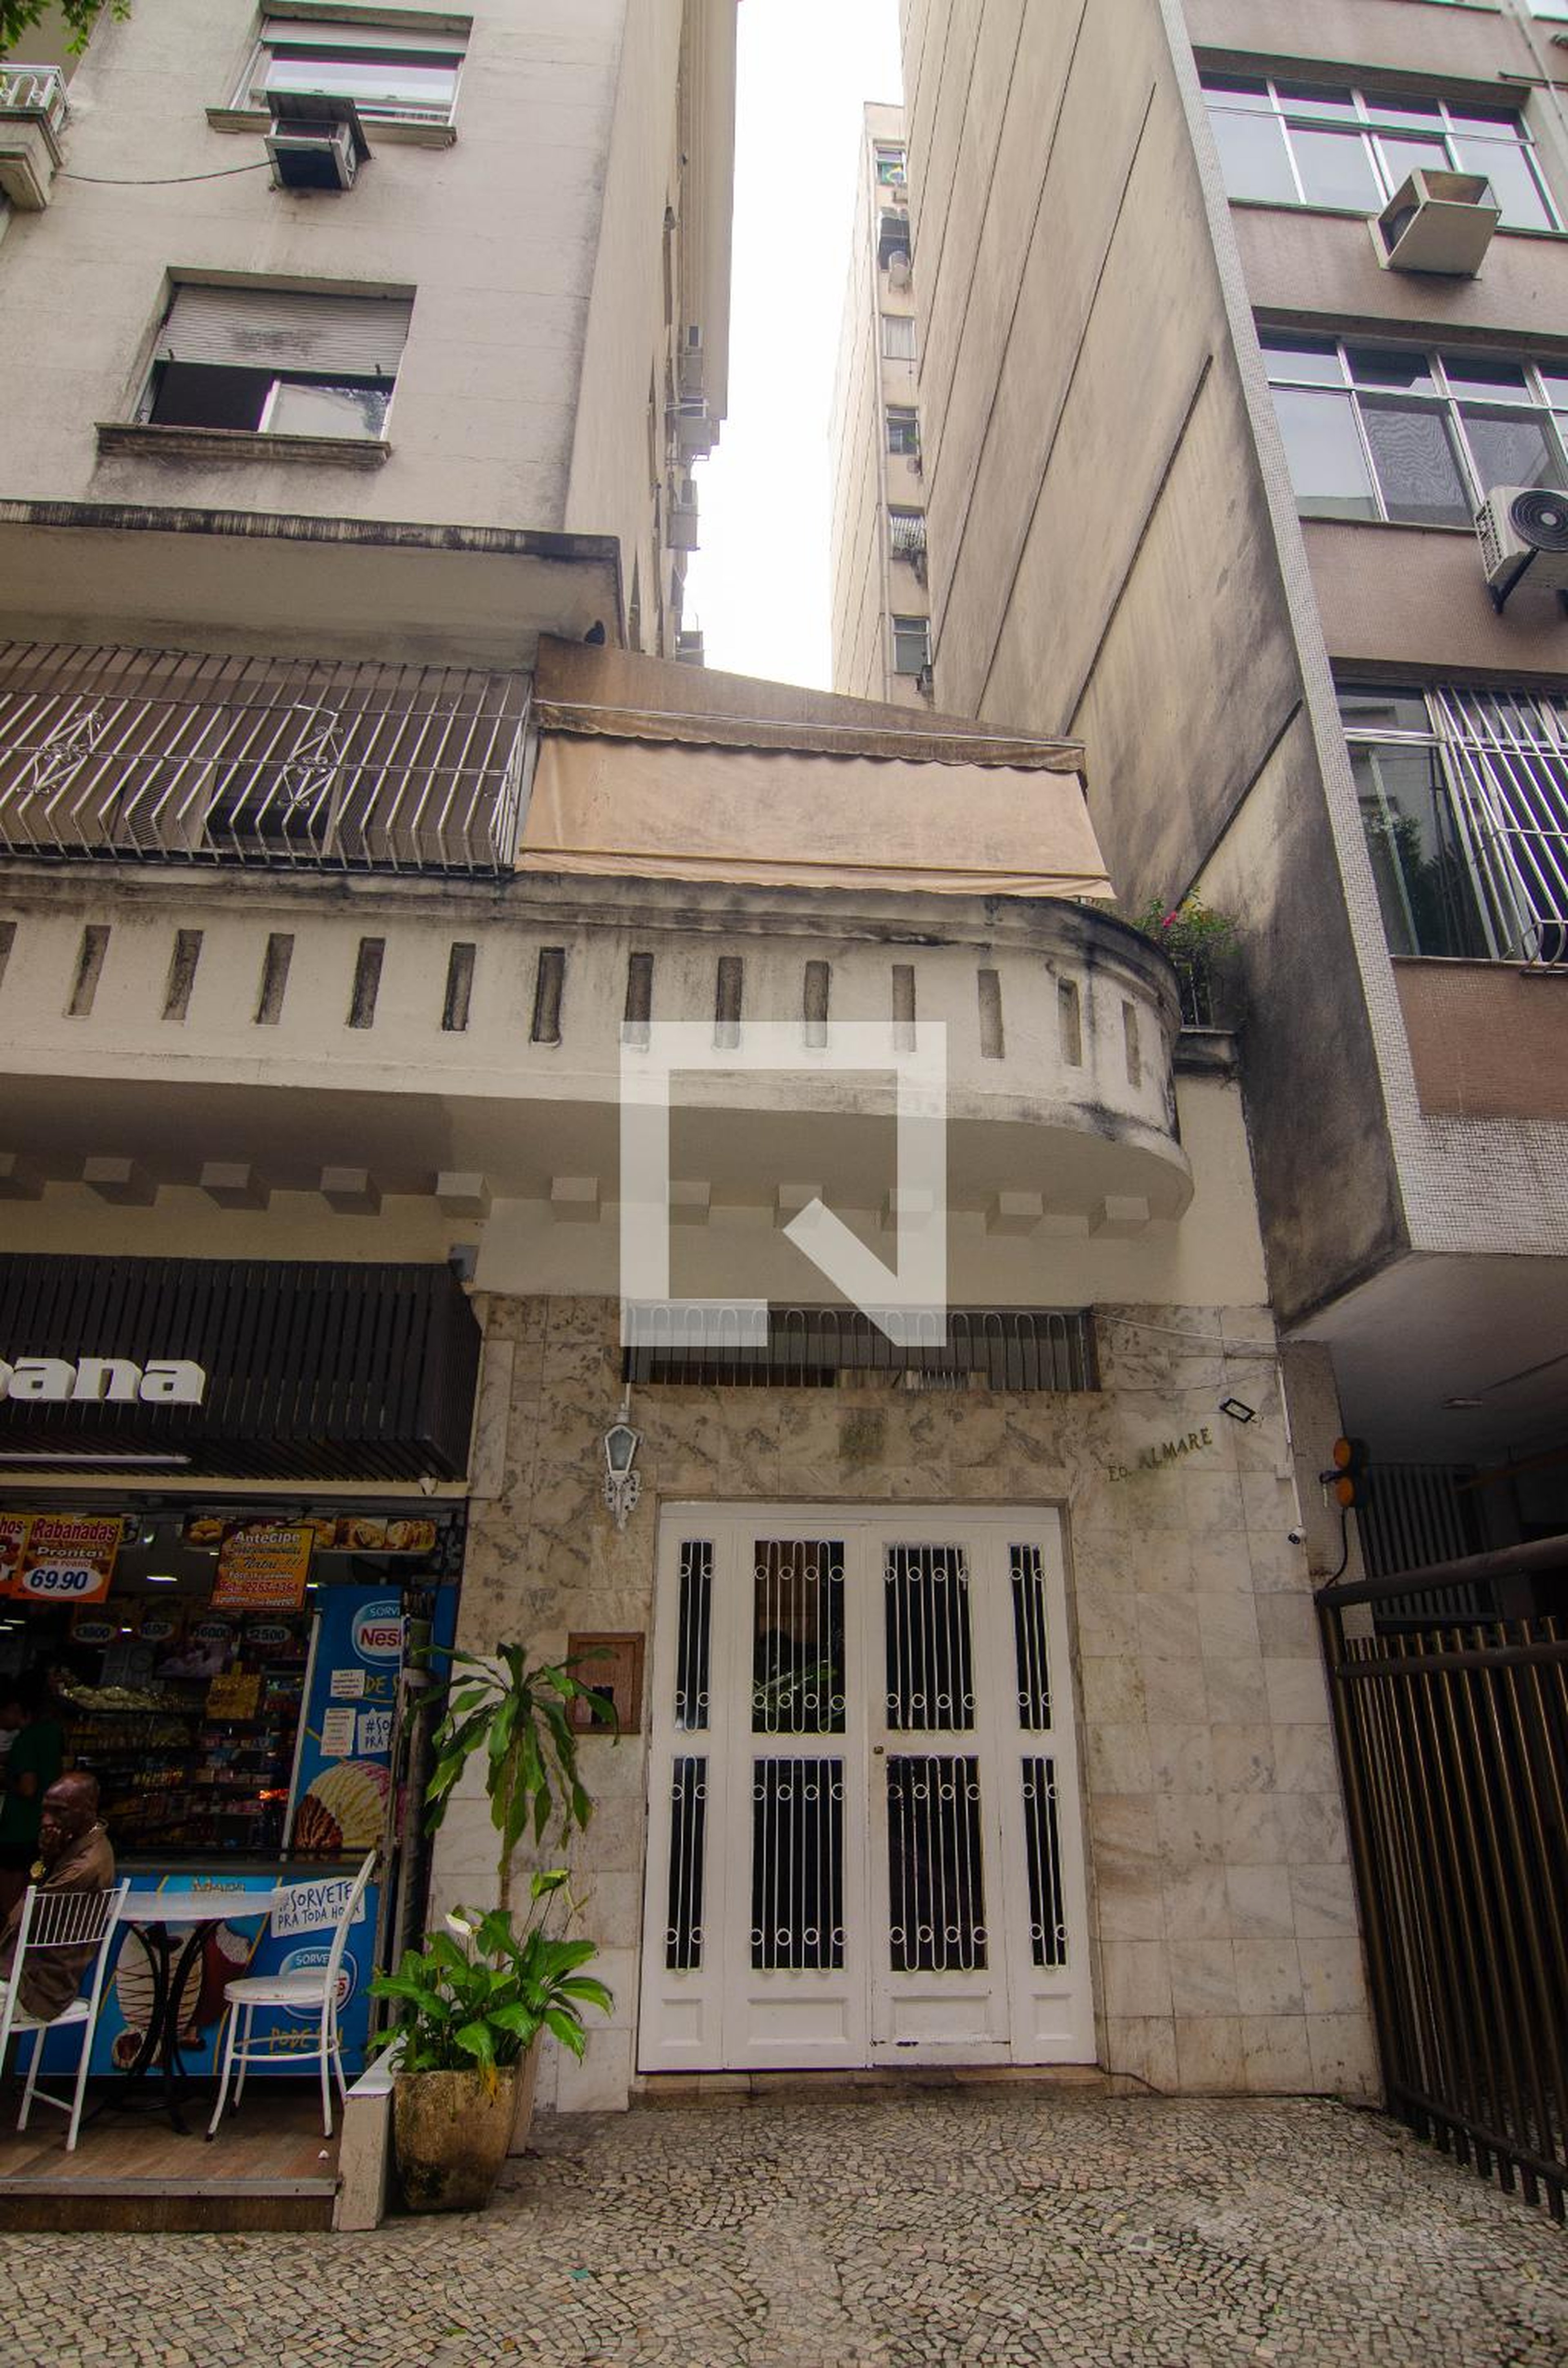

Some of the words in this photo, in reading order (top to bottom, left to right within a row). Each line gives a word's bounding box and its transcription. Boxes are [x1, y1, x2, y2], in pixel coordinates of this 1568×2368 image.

[0, 1357, 205, 1405] ana
[1139, 1427, 1212, 1469] ALMARE
[33, 1518, 115, 1541] Rabanadas
[31, 1570, 88, 1590] 69.90
[278, 1913, 299, 1930] PRA
[302, 1907, 327, 1924] TODA
[296, 1953, 343, 1966] SORVE
